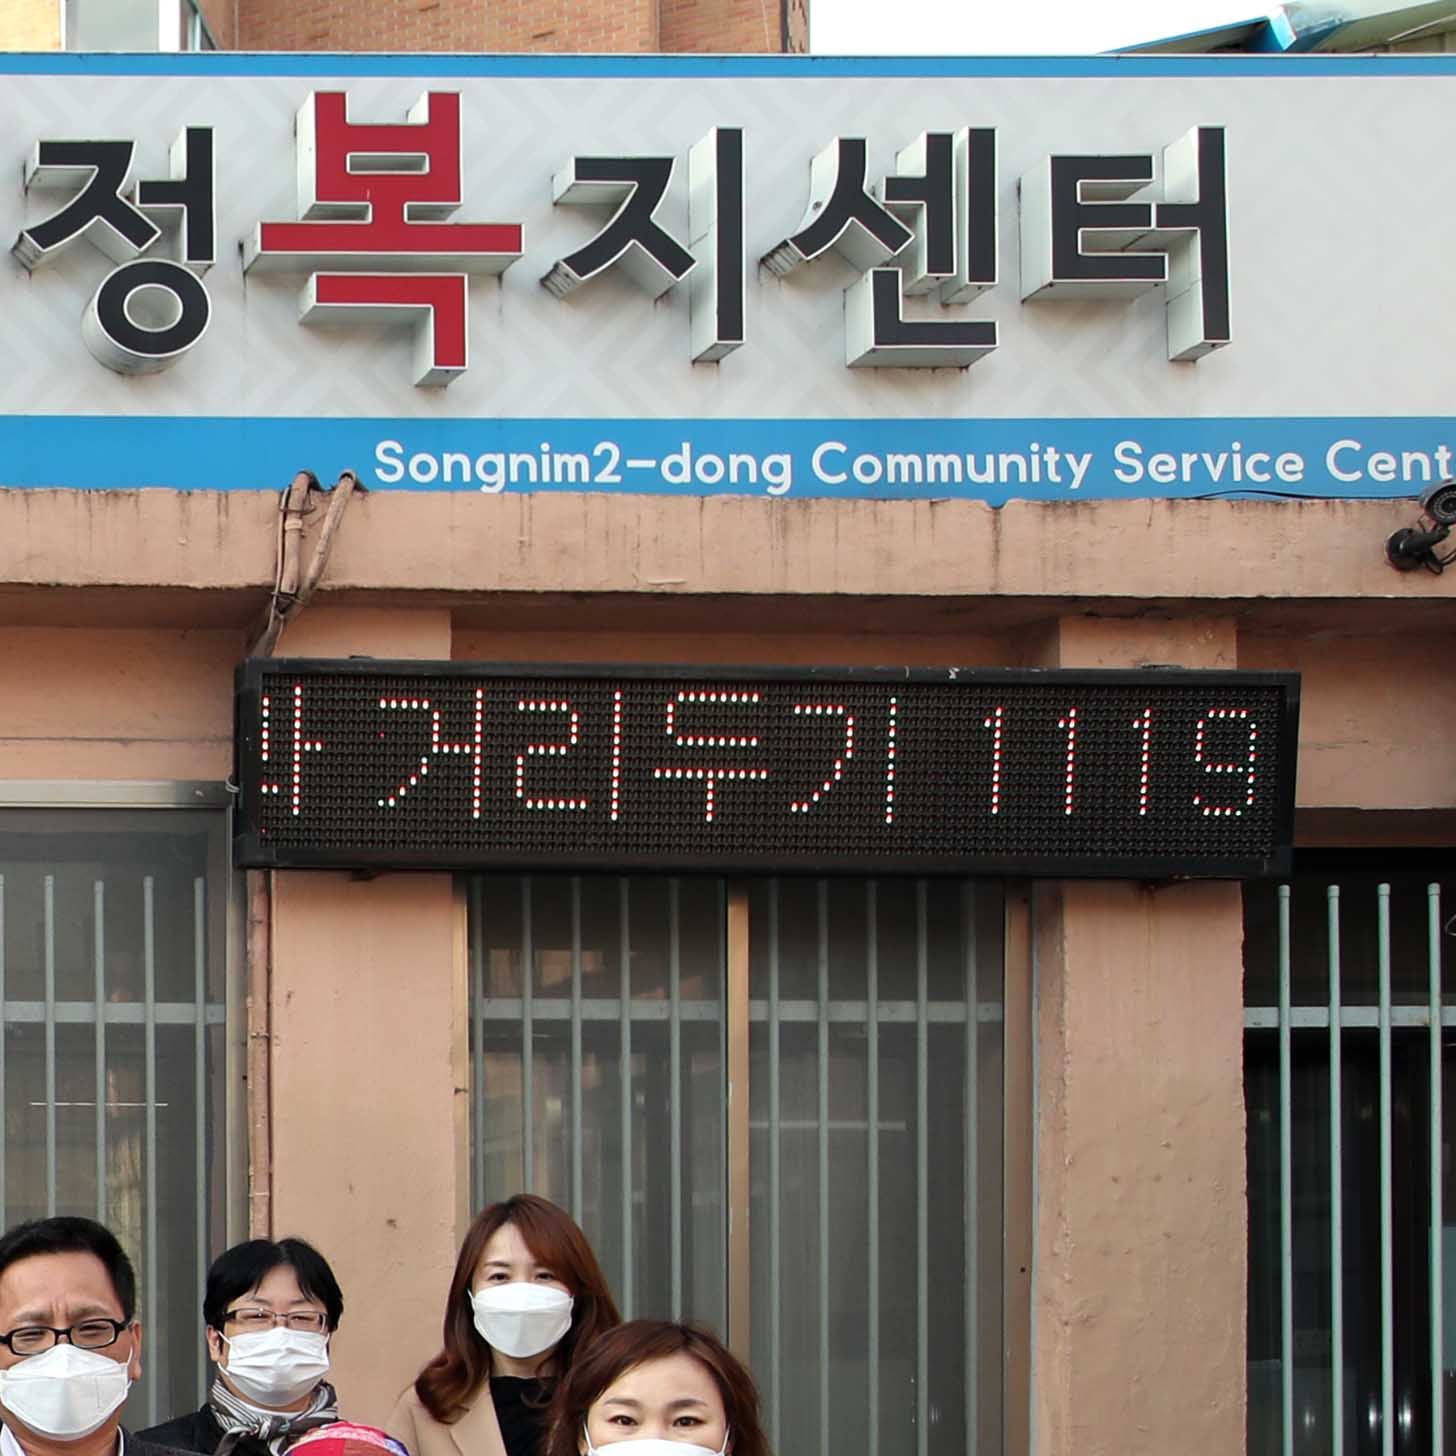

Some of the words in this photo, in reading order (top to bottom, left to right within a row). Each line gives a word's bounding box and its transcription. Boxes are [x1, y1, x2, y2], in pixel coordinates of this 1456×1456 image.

[374, 440, 793, 492] Songnim2-dong
[810, 440, 1093, 492] Community
[1112, 440, 1305, 484] Service
[1326, 439, 1456, 483] Cent
[377, 689, 897, 824] 거리두기
